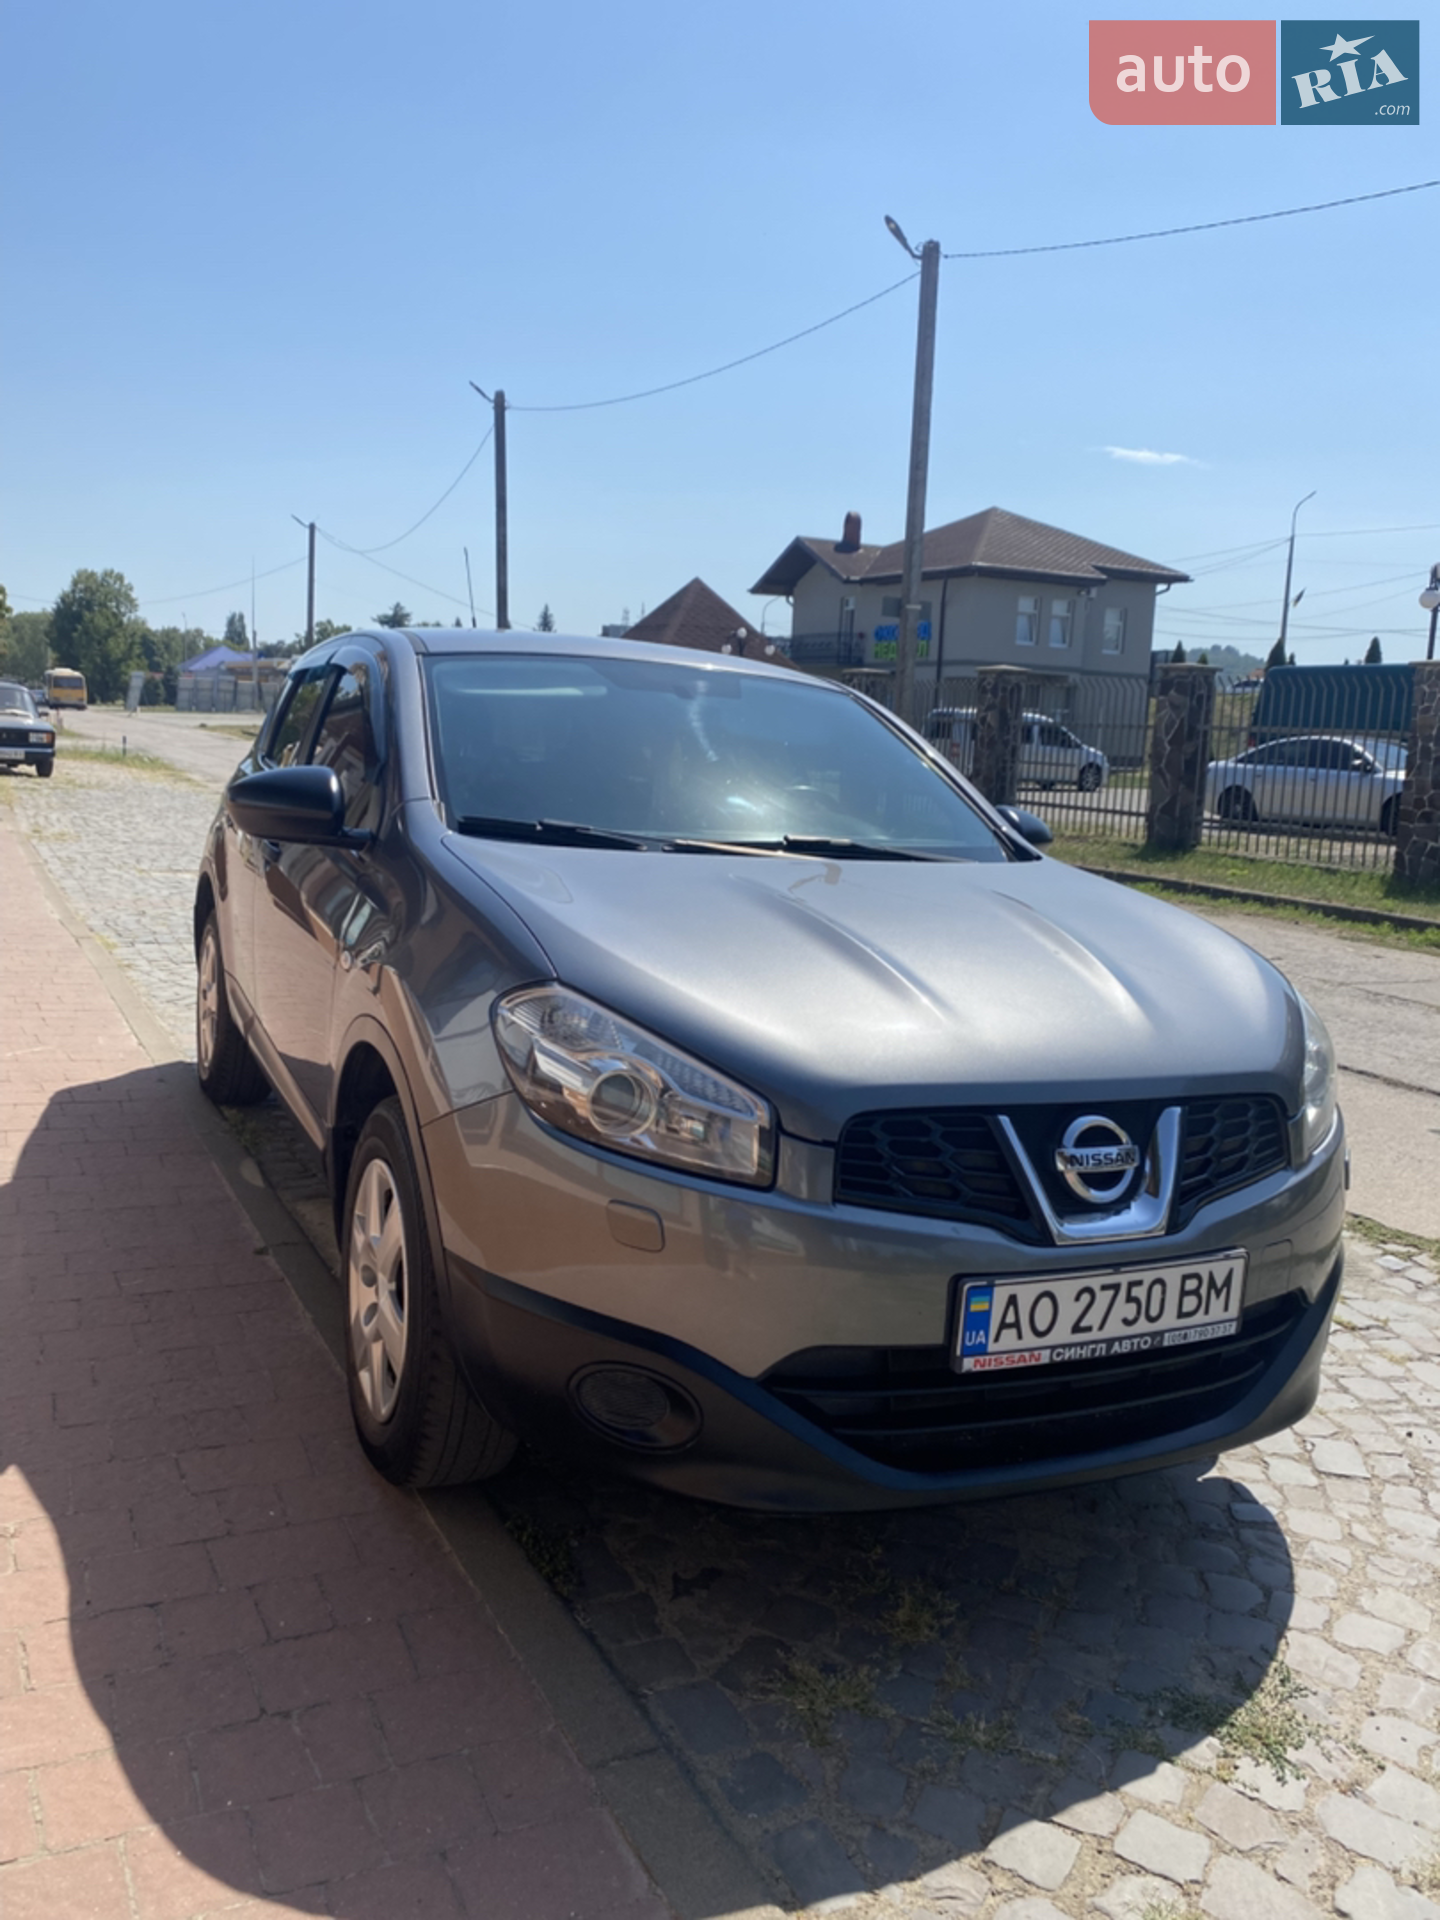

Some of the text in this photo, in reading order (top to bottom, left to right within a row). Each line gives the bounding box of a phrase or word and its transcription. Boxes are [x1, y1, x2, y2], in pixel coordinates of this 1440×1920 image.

[1069, 1151, 1136, 1167] NISSAN
[992, 1267, 1235, 1344] AO 2750 BM
[964, 1330, 987, 1347] UA
[1051, 1336, 1151, 1362] СИНГЛ АВТО
[972, 1351, 1042, 1370] NISSAN
